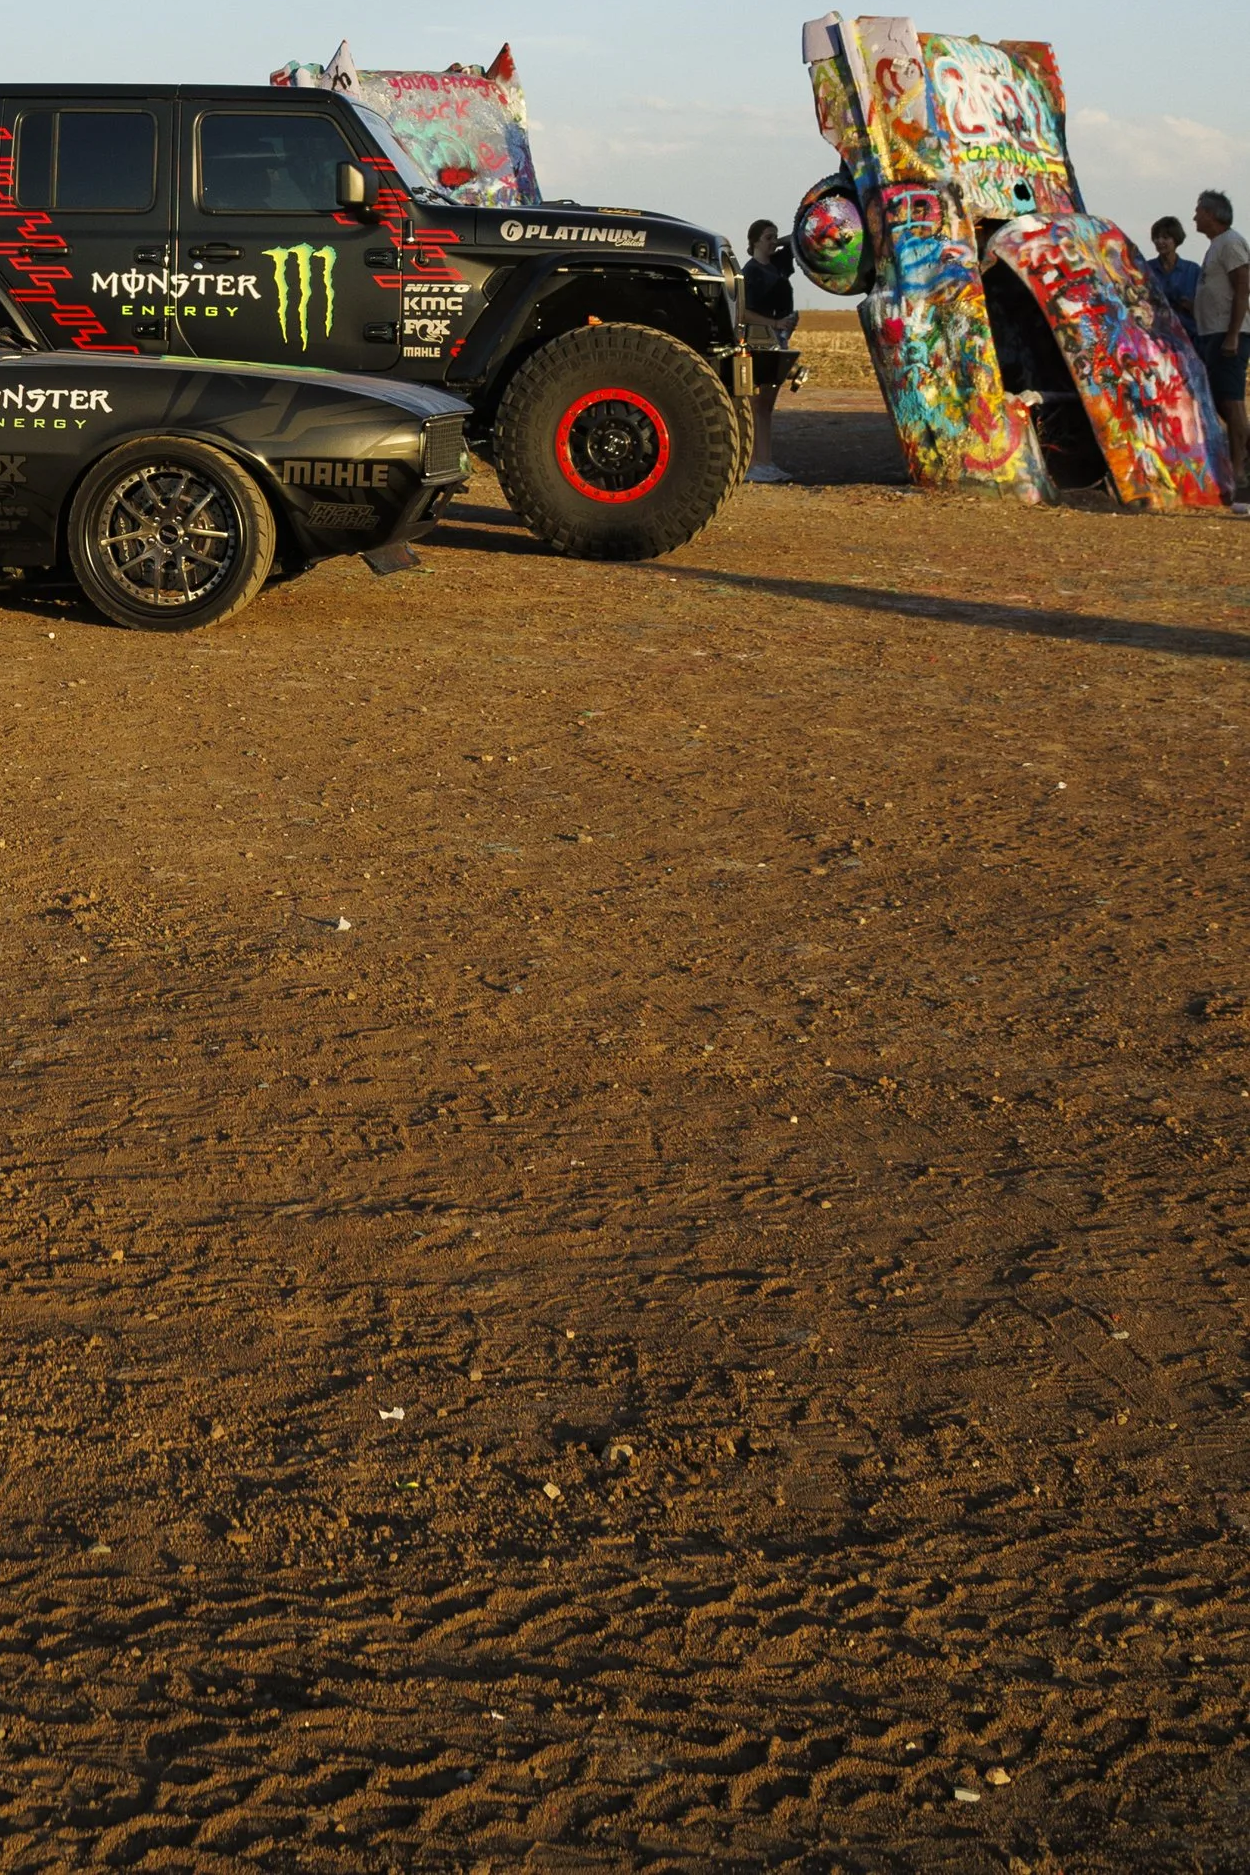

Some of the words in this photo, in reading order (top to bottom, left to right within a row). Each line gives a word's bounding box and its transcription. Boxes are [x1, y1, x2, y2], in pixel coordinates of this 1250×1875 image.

[525, 224, 647, 241] PLATINUM
[92, 268, 262, 299] MONSTER
[404, 283, 472, 293] NITTO
[122, 305, 239, 317] ENERGY
[403, 297, 462, 310] KMC
[403, 319, 450, 343] FOX
[403, 346, 440, 358] MAHLE
[283, 460, 389, 487] MAHLE
